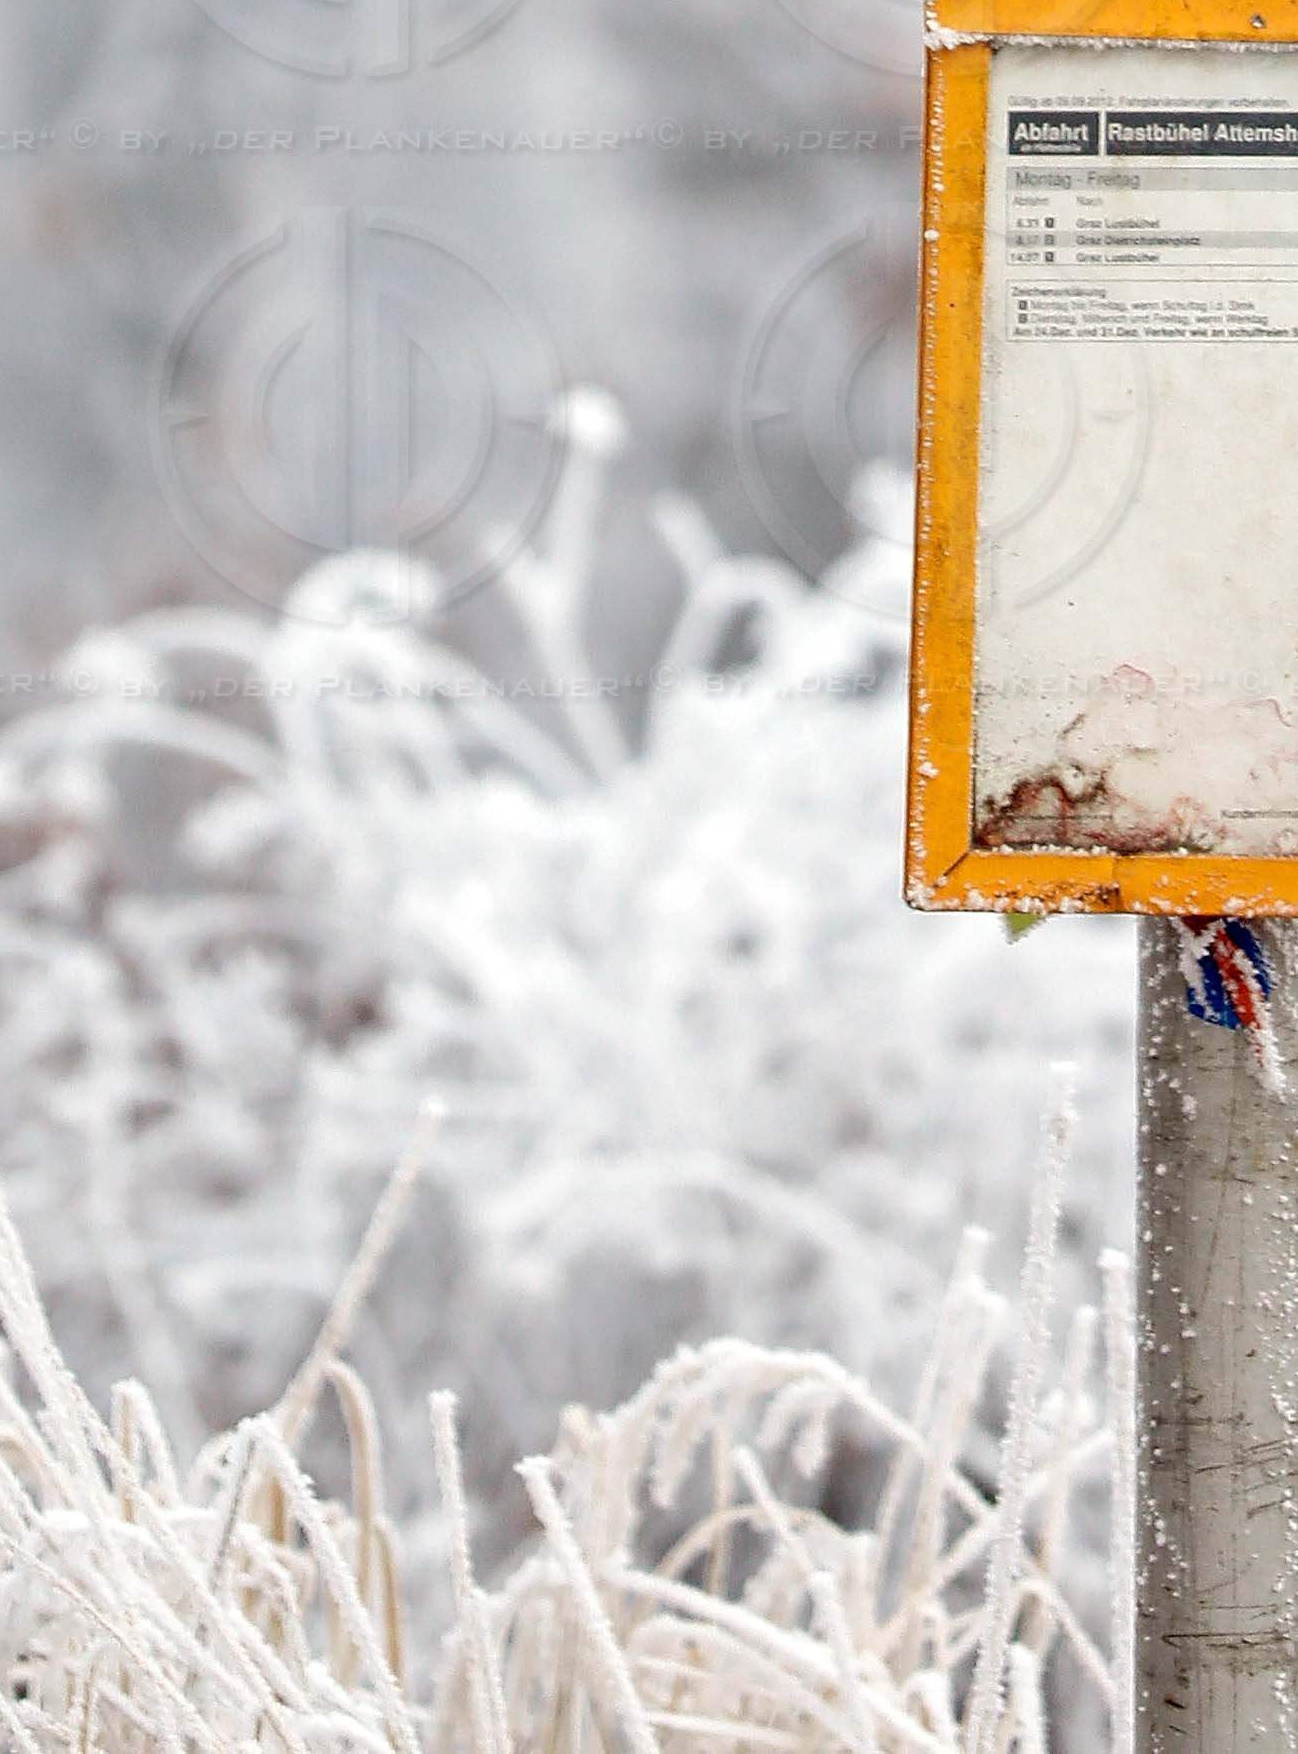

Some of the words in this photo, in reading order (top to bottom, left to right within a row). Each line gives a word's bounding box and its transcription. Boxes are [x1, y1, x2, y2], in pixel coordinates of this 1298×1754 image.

[1014, 121, 1089, 142] Abfahrt
[1108, 123, 1208, 144] Rastbühel
[1016, 171, 1072, 190] Montag
[1087, 171, 1141, 190] Freitag
